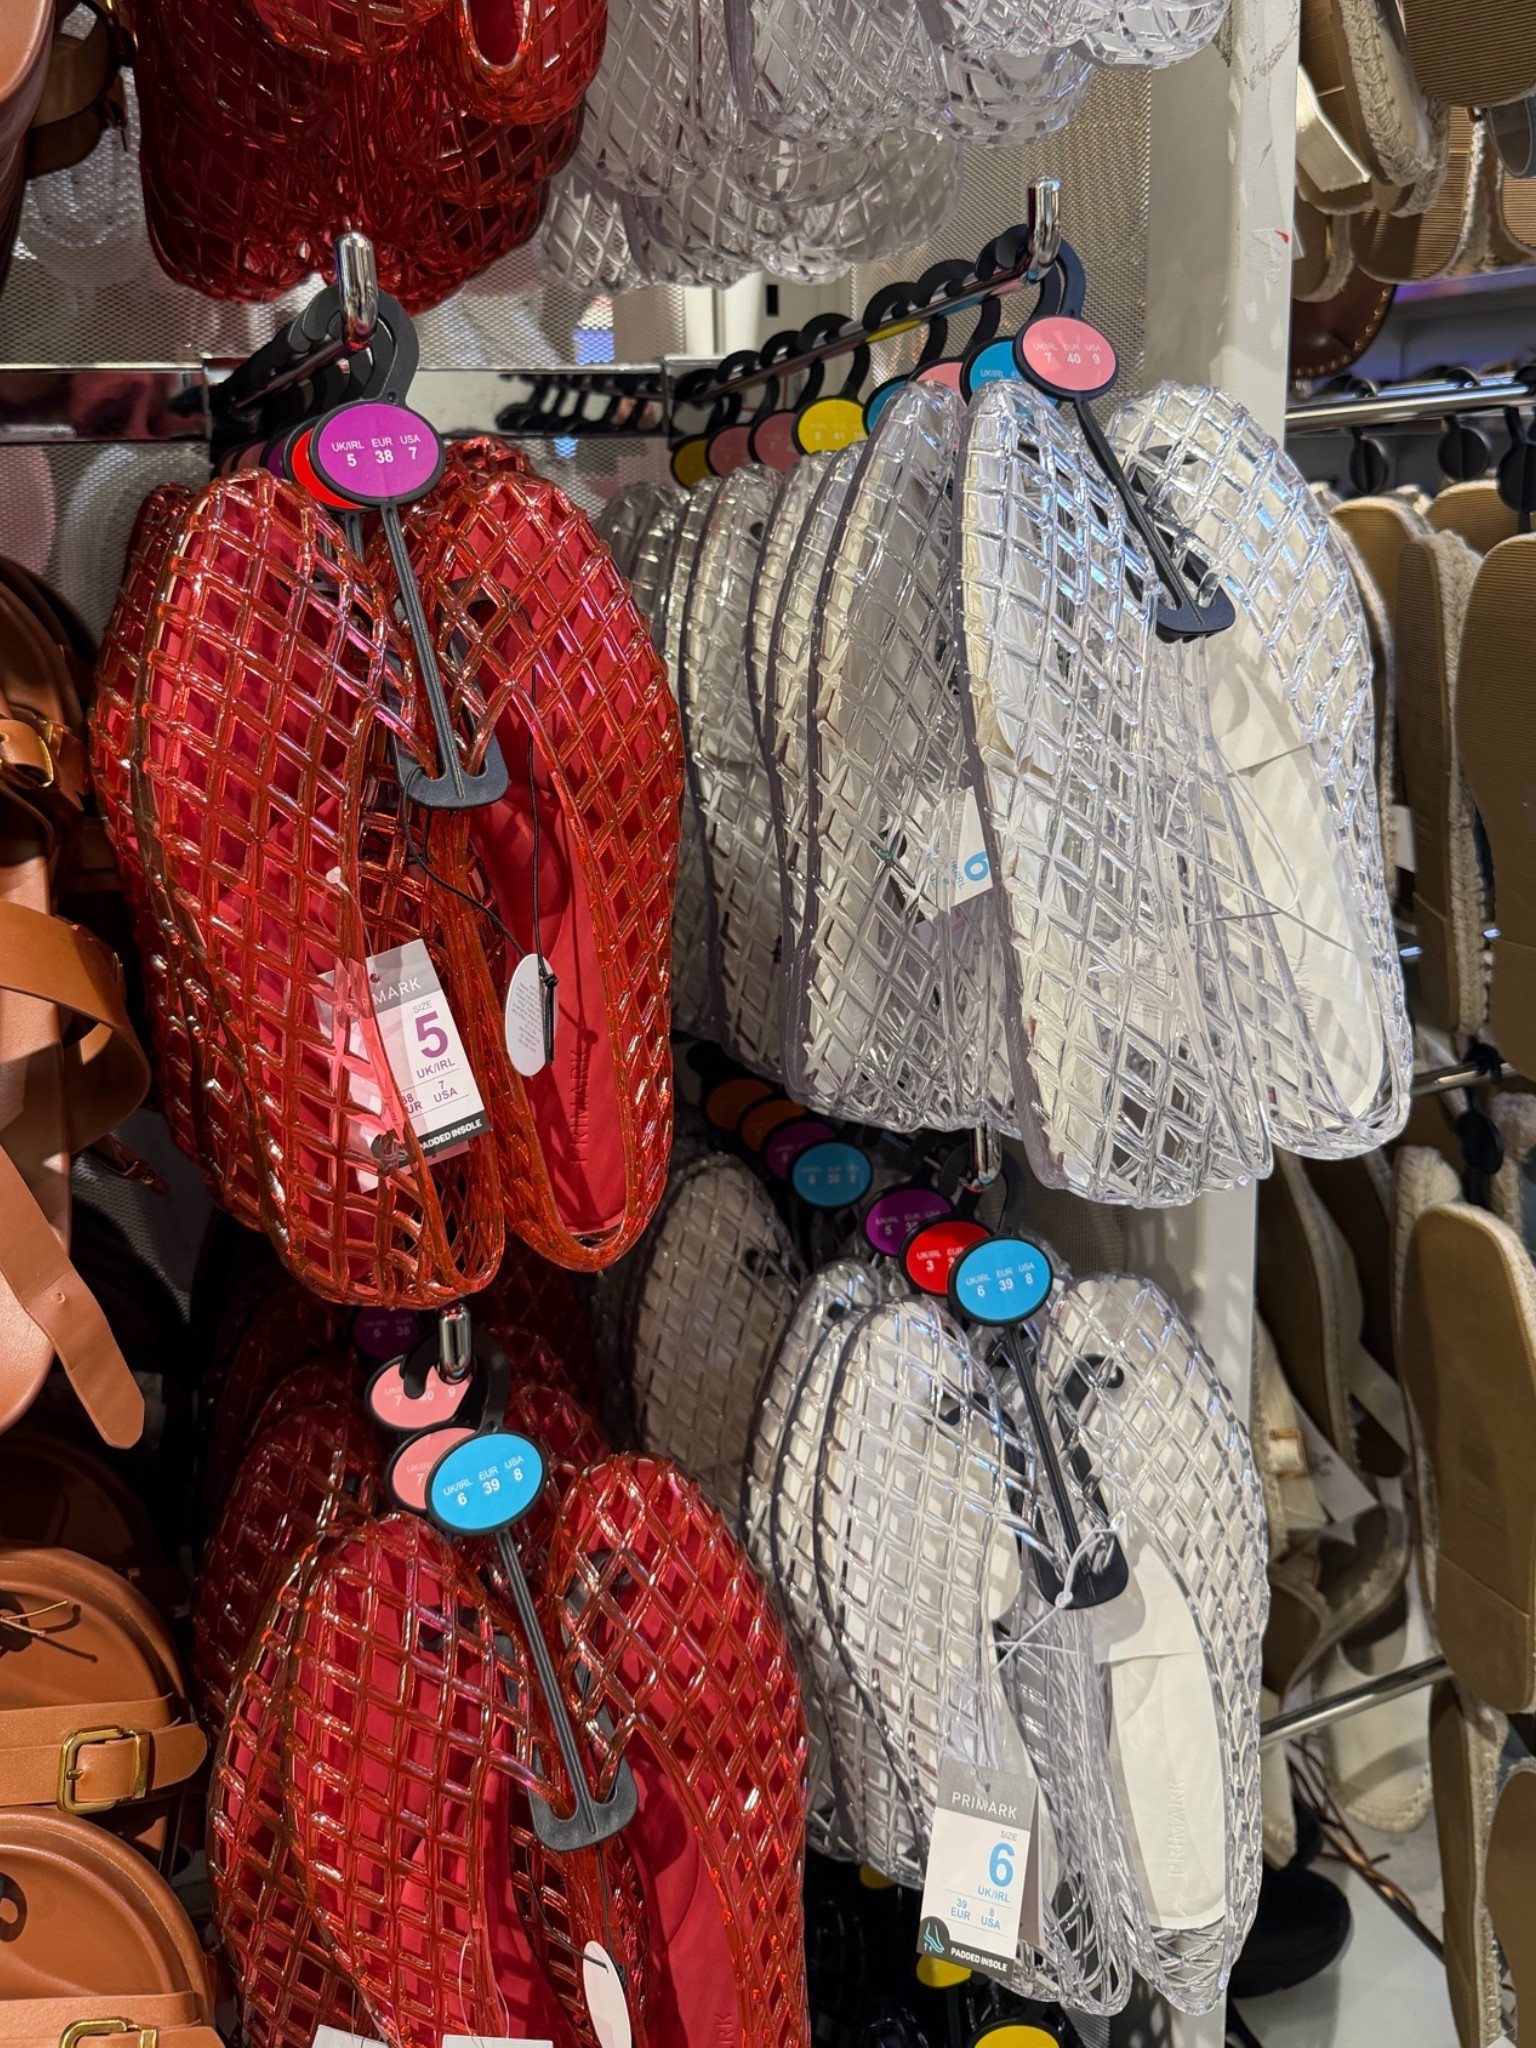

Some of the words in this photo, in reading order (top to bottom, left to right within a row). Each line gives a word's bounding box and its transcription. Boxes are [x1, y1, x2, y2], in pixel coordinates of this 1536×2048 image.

[1066, 352, 1082, 365] 40
[1091, 353, 1101, 366] 9
[1011, 369, 1023, 379] EU
[331, 439, 365, 453] UK/IRL
[371, 436, 394, 448] EUR
[400, 433, 422, 446] USA
[346, 453, 357, 468] 5
[374, 449, 395, 465] 38
[407, 446, 418, 461] 7
[964, 850, 990, 882] 6
[412, 1000, 433, 1014] SIZE
[414, 1010, 449, 1060] 5
[416, 1057, 457, 1080] UK/IRL
[438, 1081, 446, 1091] 7
[405, 1100, 424, 1115] UR
[433, 1087, 459, 1104] USA
[450, 1117, 483, 1142] INSOLE
[884, 1224, 893, 1236] 5
[925, 1259, 935, 1273] 3
[996, 1266, 1014, 1279] EUR
[1018, 1261, 1036, 1273] USA
[976, 1285, 986, 1298] 6
[998, 1278, 1015, 1293] 39
[1025, 1272, 1033, 1285] 8
[394, 1394, 404, 1407] 7
[447, 1386, 457, 1398] 9
[416, 1472, 425, 1486] 7
[442, 1477, 474, 1497] UK/IRL
[478, 1464, 500, 1481] EUR
[503, 1454, 525, 1469] USA
[456, 1491, 468, 1506] 6
[481, 1477, 501, 1496] 39
[512, 1467, 524, 1482] 8
[951, 1790, 1018, 1820] PRIMARK
[1000, 1830, 1018, 1842] SIZE
[1166, 1778, 1186, 1880] PRIMARK
[988, 1841, 1016, 1889] 6
[977, 1885, 1011, 1904] UK/IRL
[955, 1897, 968, 1910] 39
[988, 1907, 996, 1918] 8
[950, 1907, 972, 1922] EUR
[981, 1916, 1002, 1931] USA
[950, 1946, 982, 1966] PADDED
[980, 1955, 1009, 1973] INSOLE
